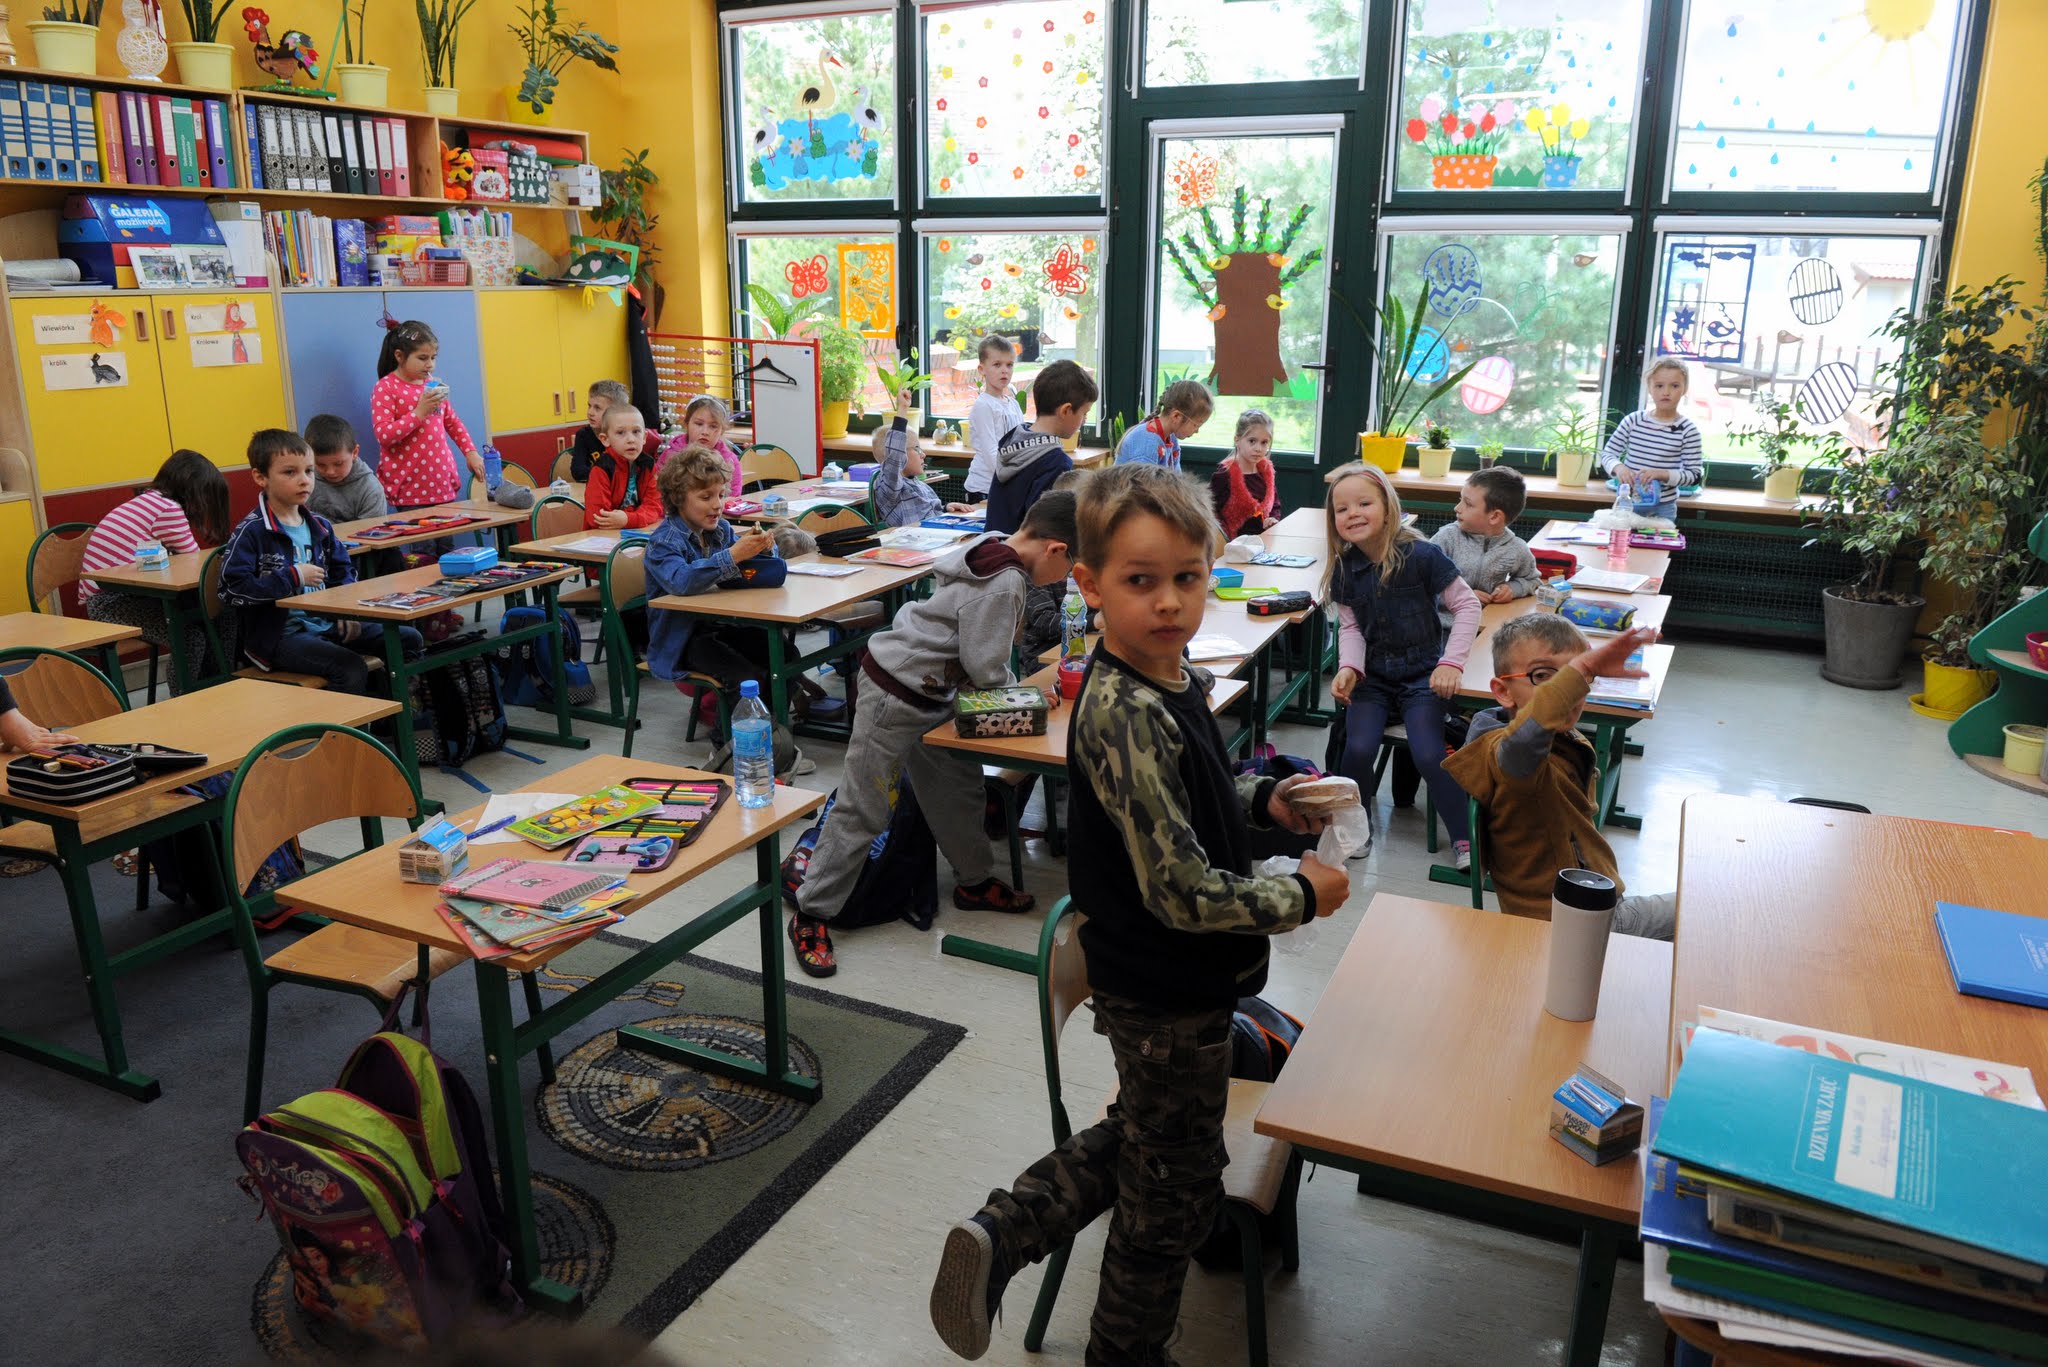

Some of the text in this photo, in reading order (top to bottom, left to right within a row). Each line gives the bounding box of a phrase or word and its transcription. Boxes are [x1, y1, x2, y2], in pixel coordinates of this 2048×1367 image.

[111, 208, 162, 219] GALERIA
[117, 217, 166, 227] możliwości
[41, 325, 75, 333] Wiewiórka
[1808, 1075, 1841, 1162] DZIENNIK ZAJĘĆ
